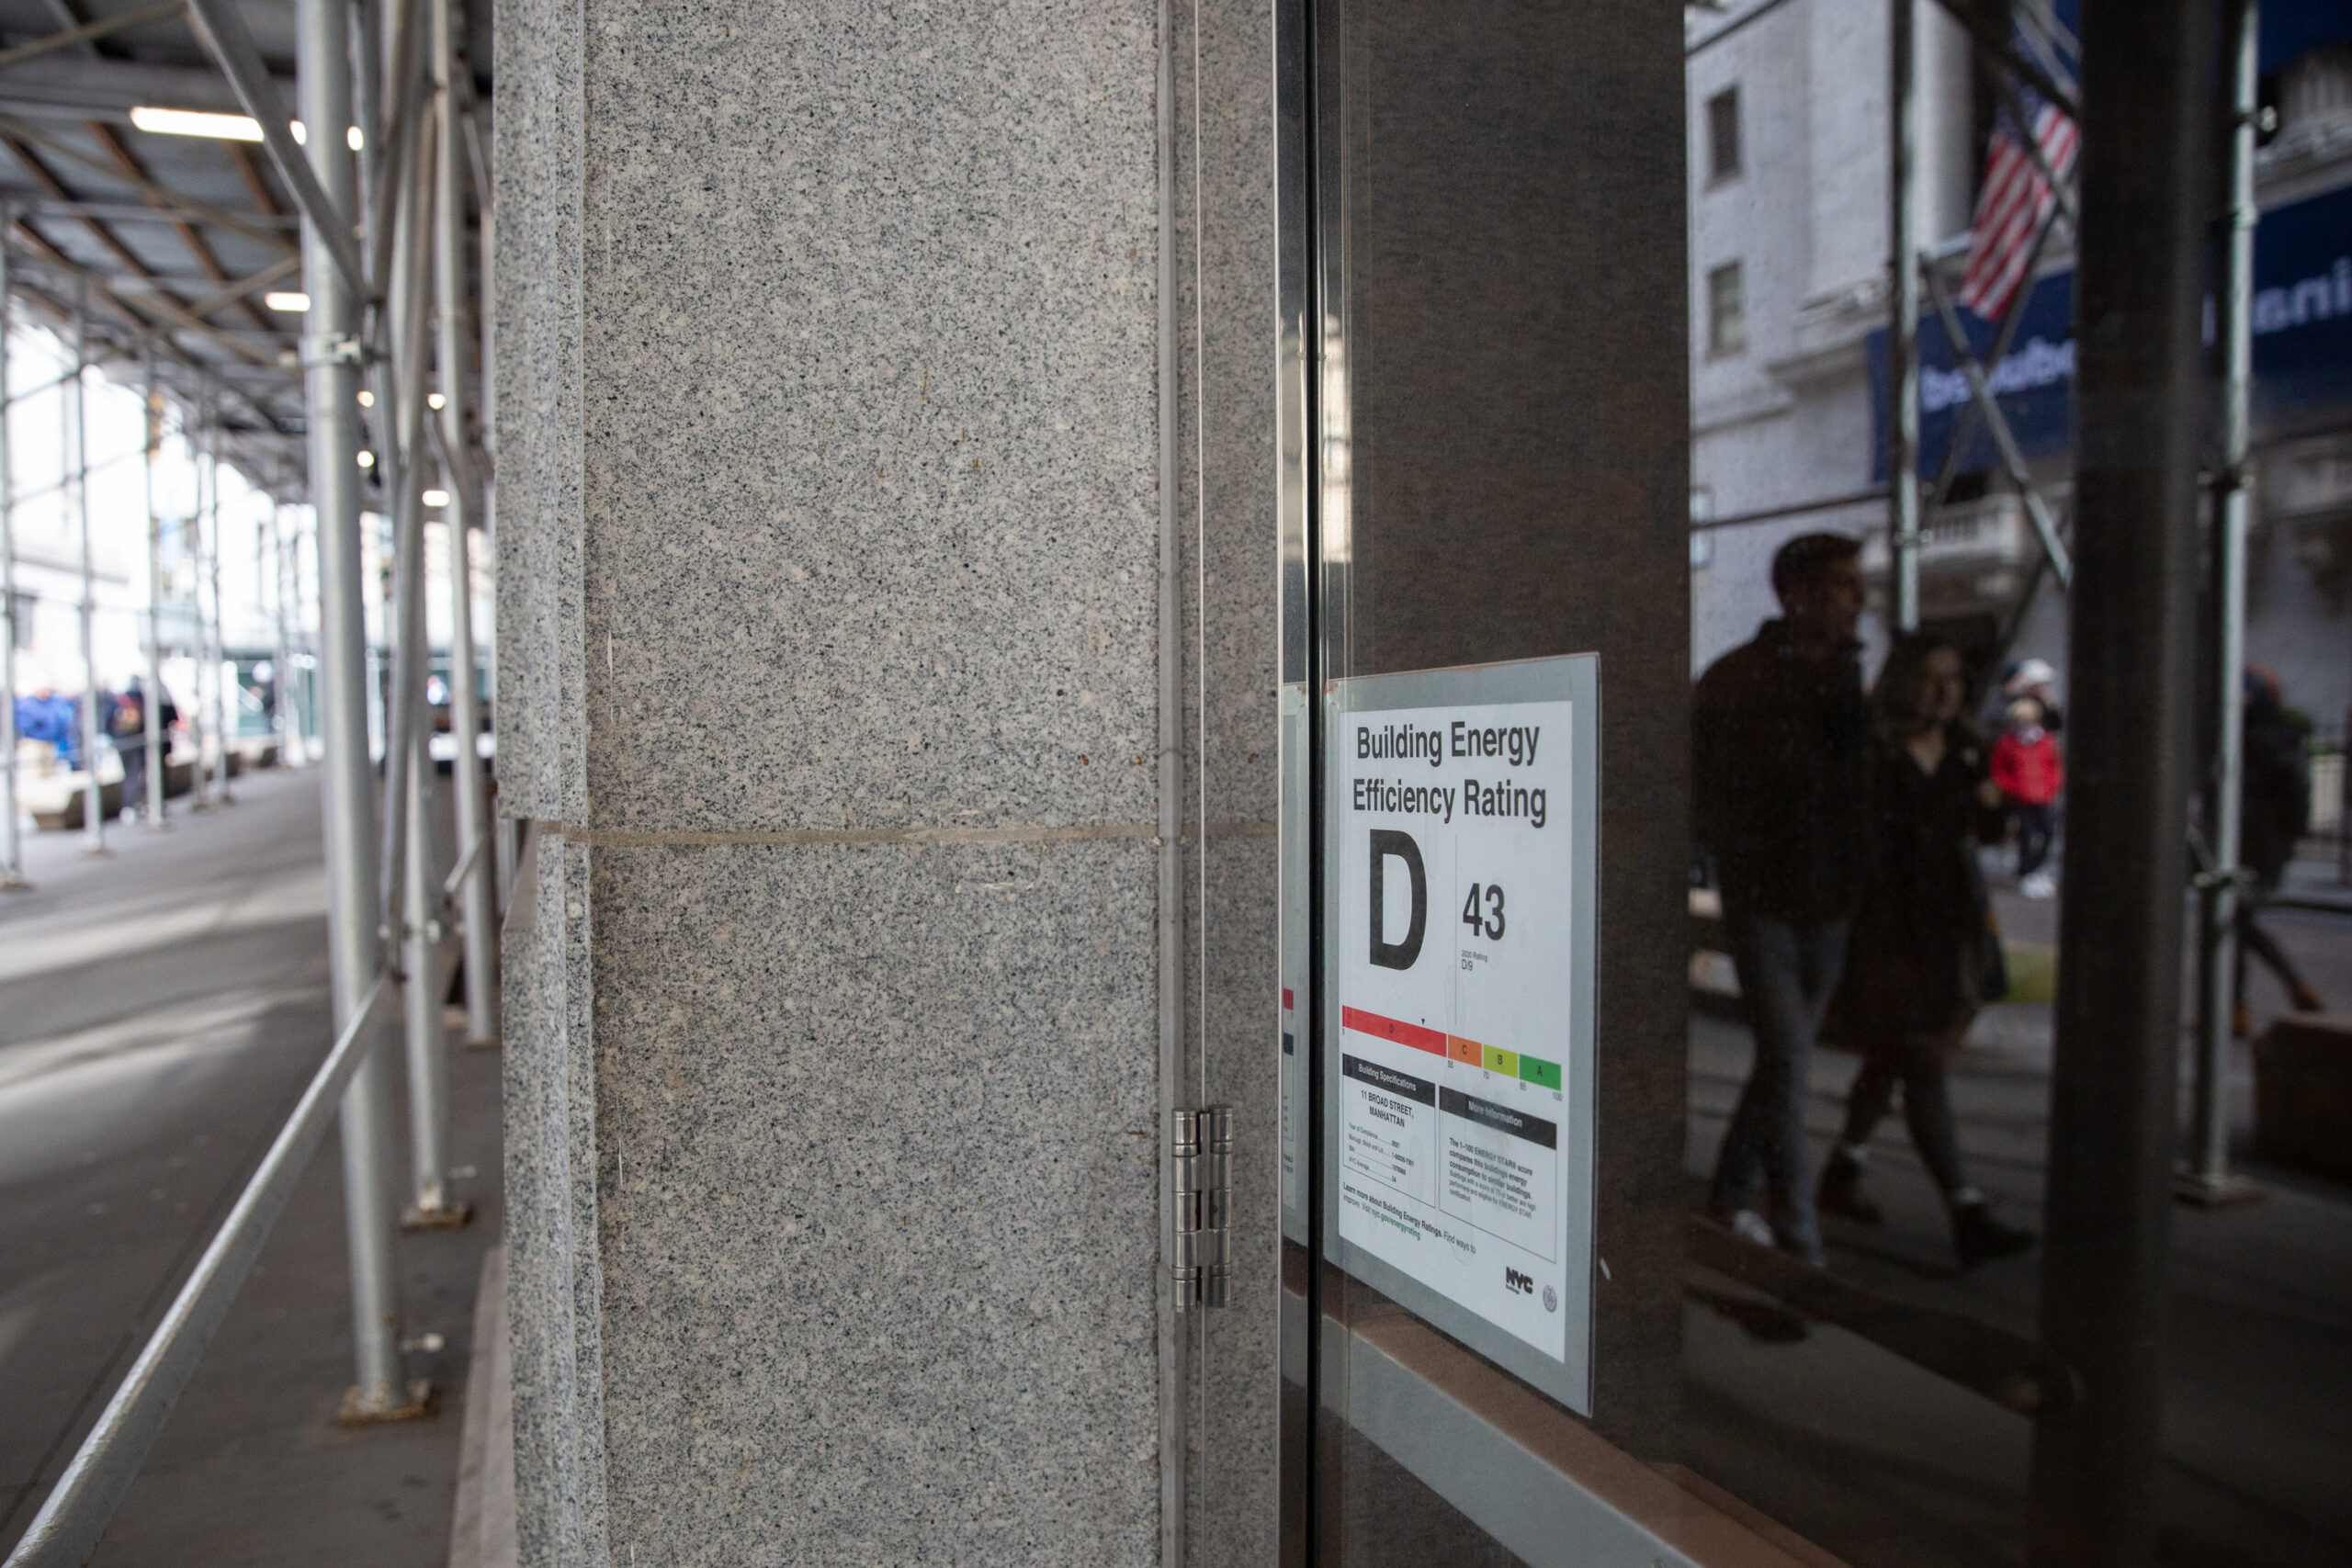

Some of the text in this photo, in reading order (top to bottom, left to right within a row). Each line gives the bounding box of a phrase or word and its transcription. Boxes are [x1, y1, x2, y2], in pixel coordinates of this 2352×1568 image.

[1357, 721, 1540, 767] Building Energy
[1353, 778, 1546, 829] Efficiency Rating
[1369, 829, 1427, 971] D
[1463, 883, 1506, 942] 43
[1462, 950, 1487, 964] 2020 Rating
[1462, 958, 1473, 971] D/9
[1389, 1023, 1543, 1077] D C B A
[1359, 1064, 1417, 1091] Building Specifications
[1448, 1060, 1453, 1069] 55
[1483, 1070, 1489, 1080] 70
[1553, 1092, 1563, 1102] 100
[1362, 1089, 1414, 1118] 11 BROAD STREET,
[1370, 1106, 1405, 1127] MANHATTAN
[1468, 1100, 1522, 1126] More Information
[1450, 1137, 1459, 1147] The
[1475, 1146, 1497, 1161] ENERGY
[1517, 1165, 1532, 1176] score
[1450, 1150, 1473, 1164] compares
[1475, 1158, 1483, 1168] this
[1510, 1173, 1527, 1187] energy
[1450, 1161, 1532, 1200] consumption to similar buildings.
[1450, 1169, 1466, 1182] Buildings
[1479, 1182, 1489, 1192] score
[1343, 1182, 1476, 1254] Learn more about Building Energy Ratings. Find ways to
[1362, 1201, 1371, 1213] Visit
[1371, 1209, 1420, 1241] nyc.gov/energyrating
[1499, 1199, 1518, 1213] ENERGY
[1519, 1208, 1532, 1218] STAR
[1506, 1267, 1532, 1294] NYC
